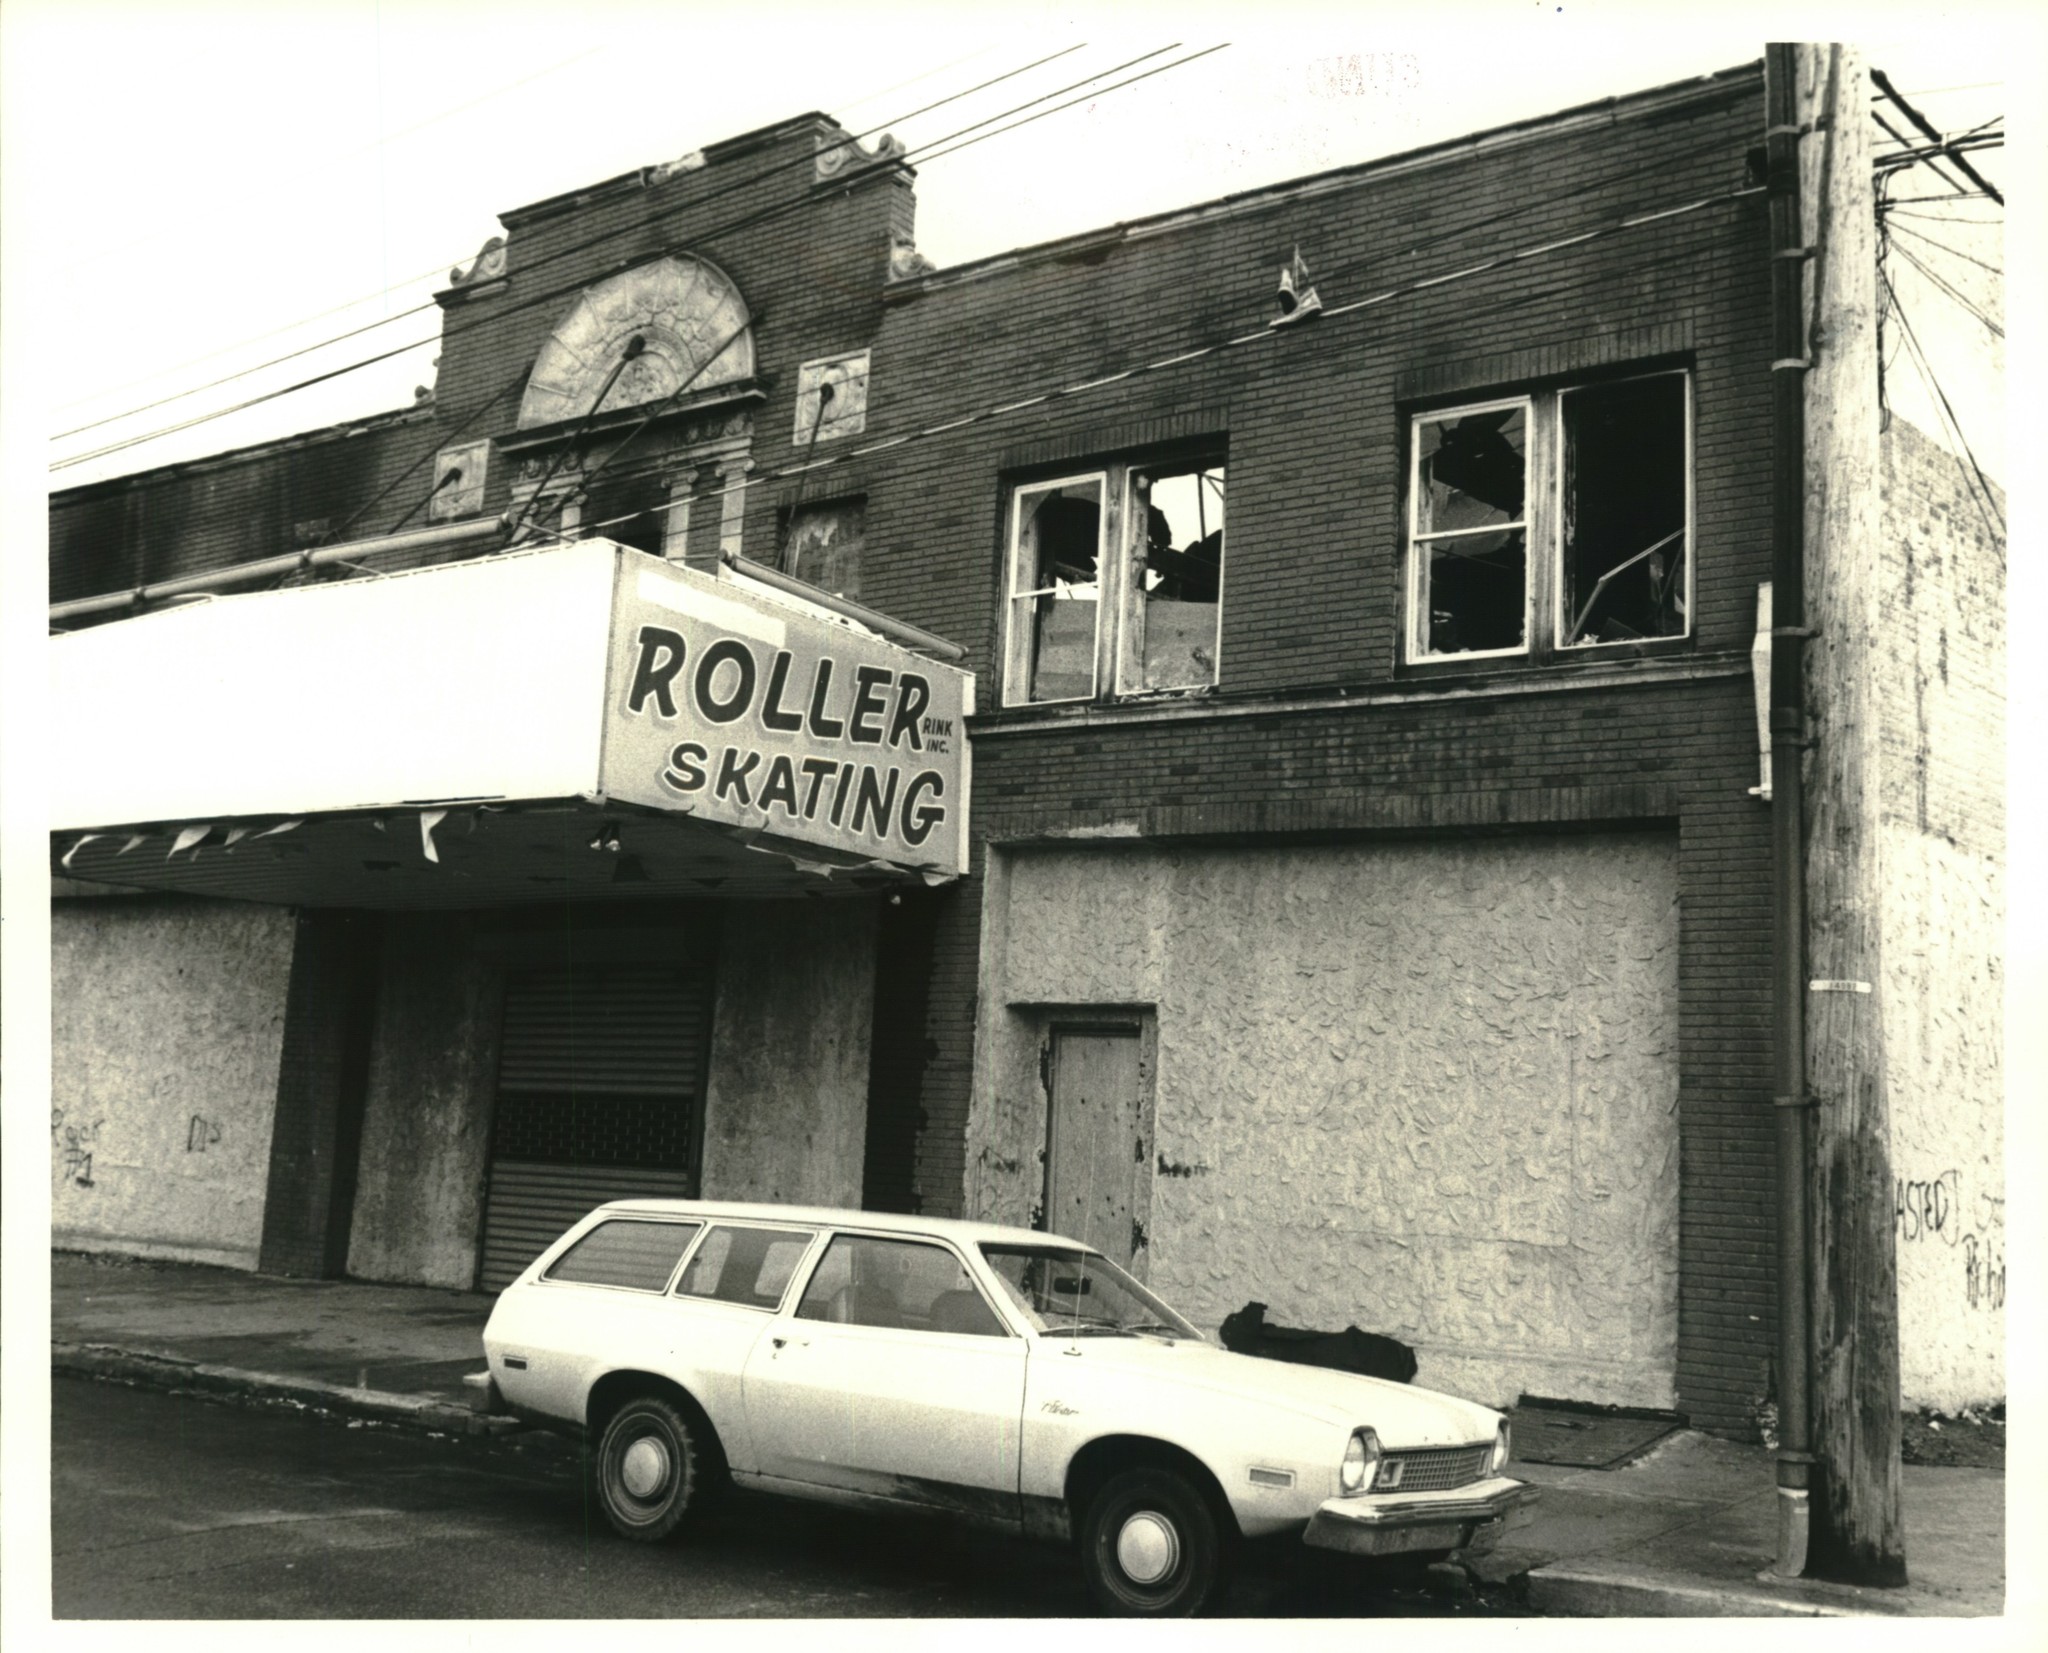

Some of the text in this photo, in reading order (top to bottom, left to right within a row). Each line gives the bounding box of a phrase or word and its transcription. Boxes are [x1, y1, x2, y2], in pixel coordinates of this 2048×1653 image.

[628, 626, 930, 752] ROLLER
[922, 717, 953, 737] RINK
[926, 739, 949, 754] INC.
[663, 743, 946, 847] SKATING
[1893, 1177, 1949, 1243] ASTED
